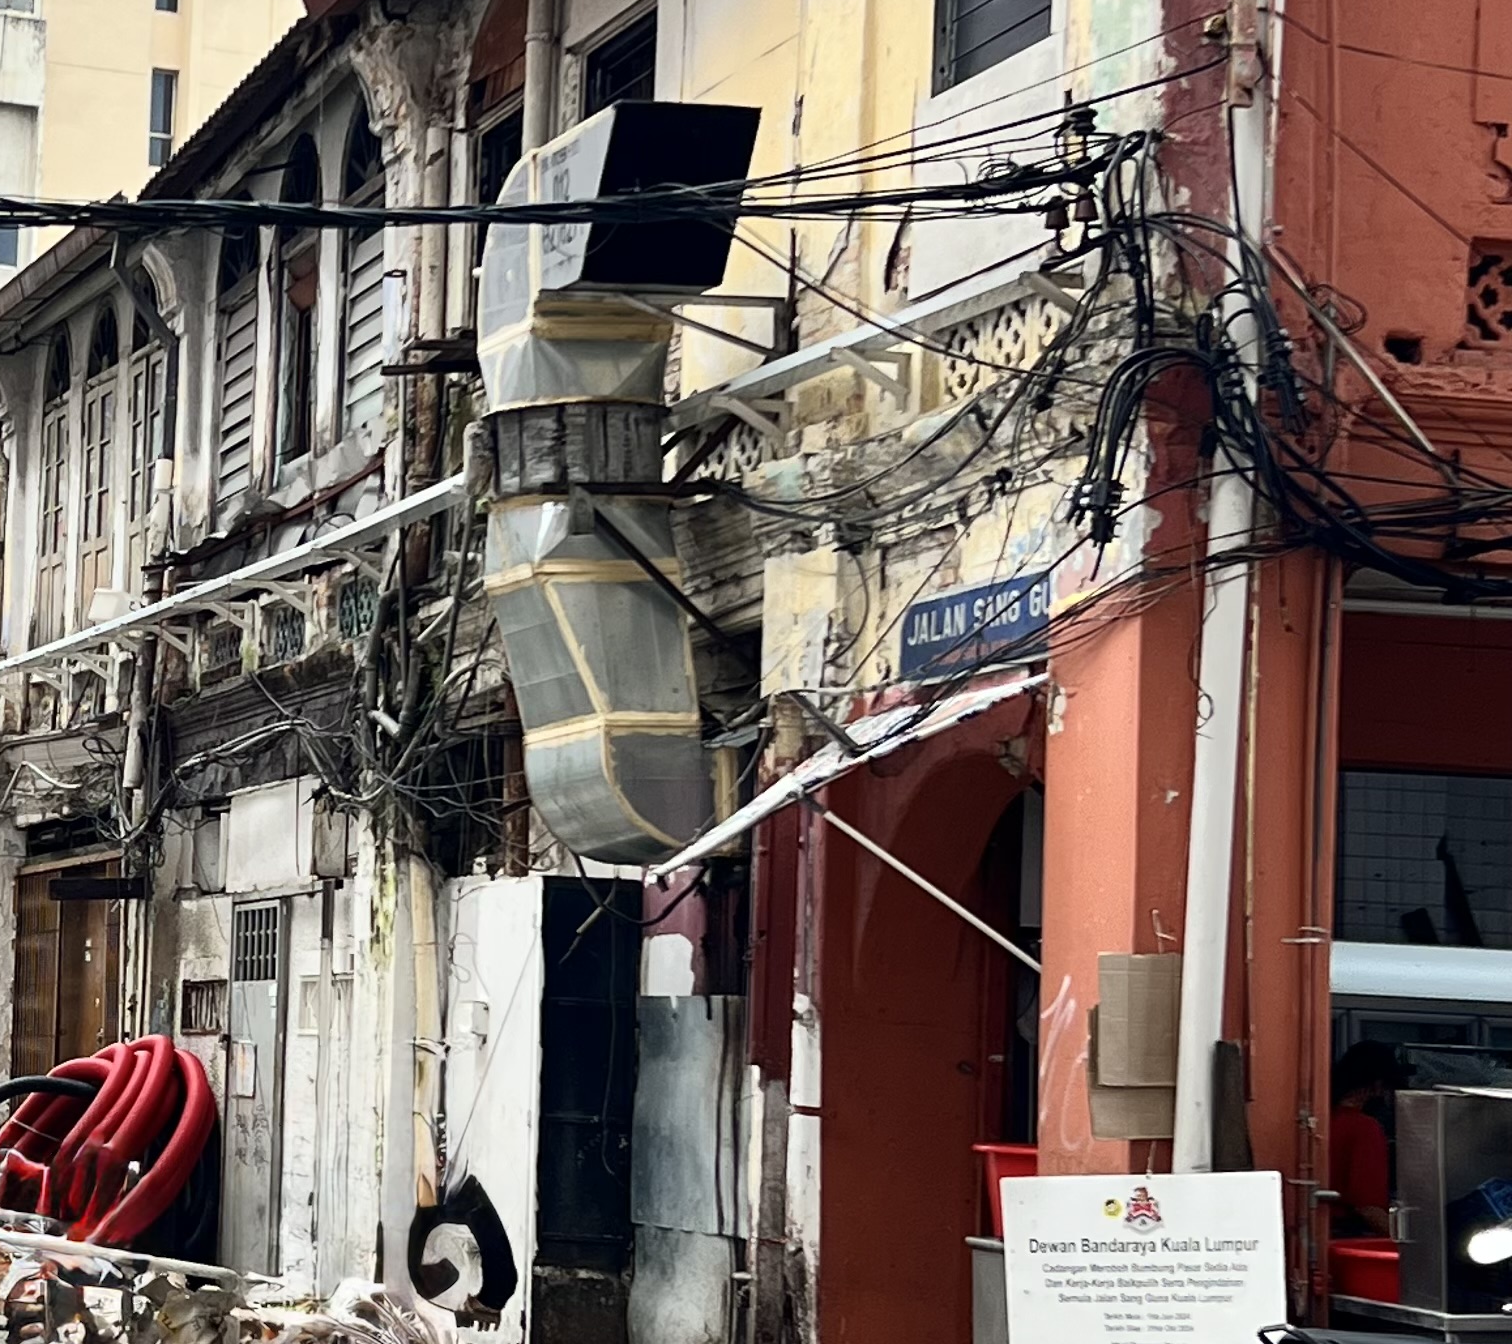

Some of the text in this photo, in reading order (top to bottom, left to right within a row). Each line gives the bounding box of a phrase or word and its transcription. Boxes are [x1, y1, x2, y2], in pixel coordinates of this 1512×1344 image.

[907, 603, 966, 646] JALAN
[973, 590, 1021, 628] SANG
[1029, 1237, 1259, 1256] Dewan Bandaraya Kuala Lumpur
